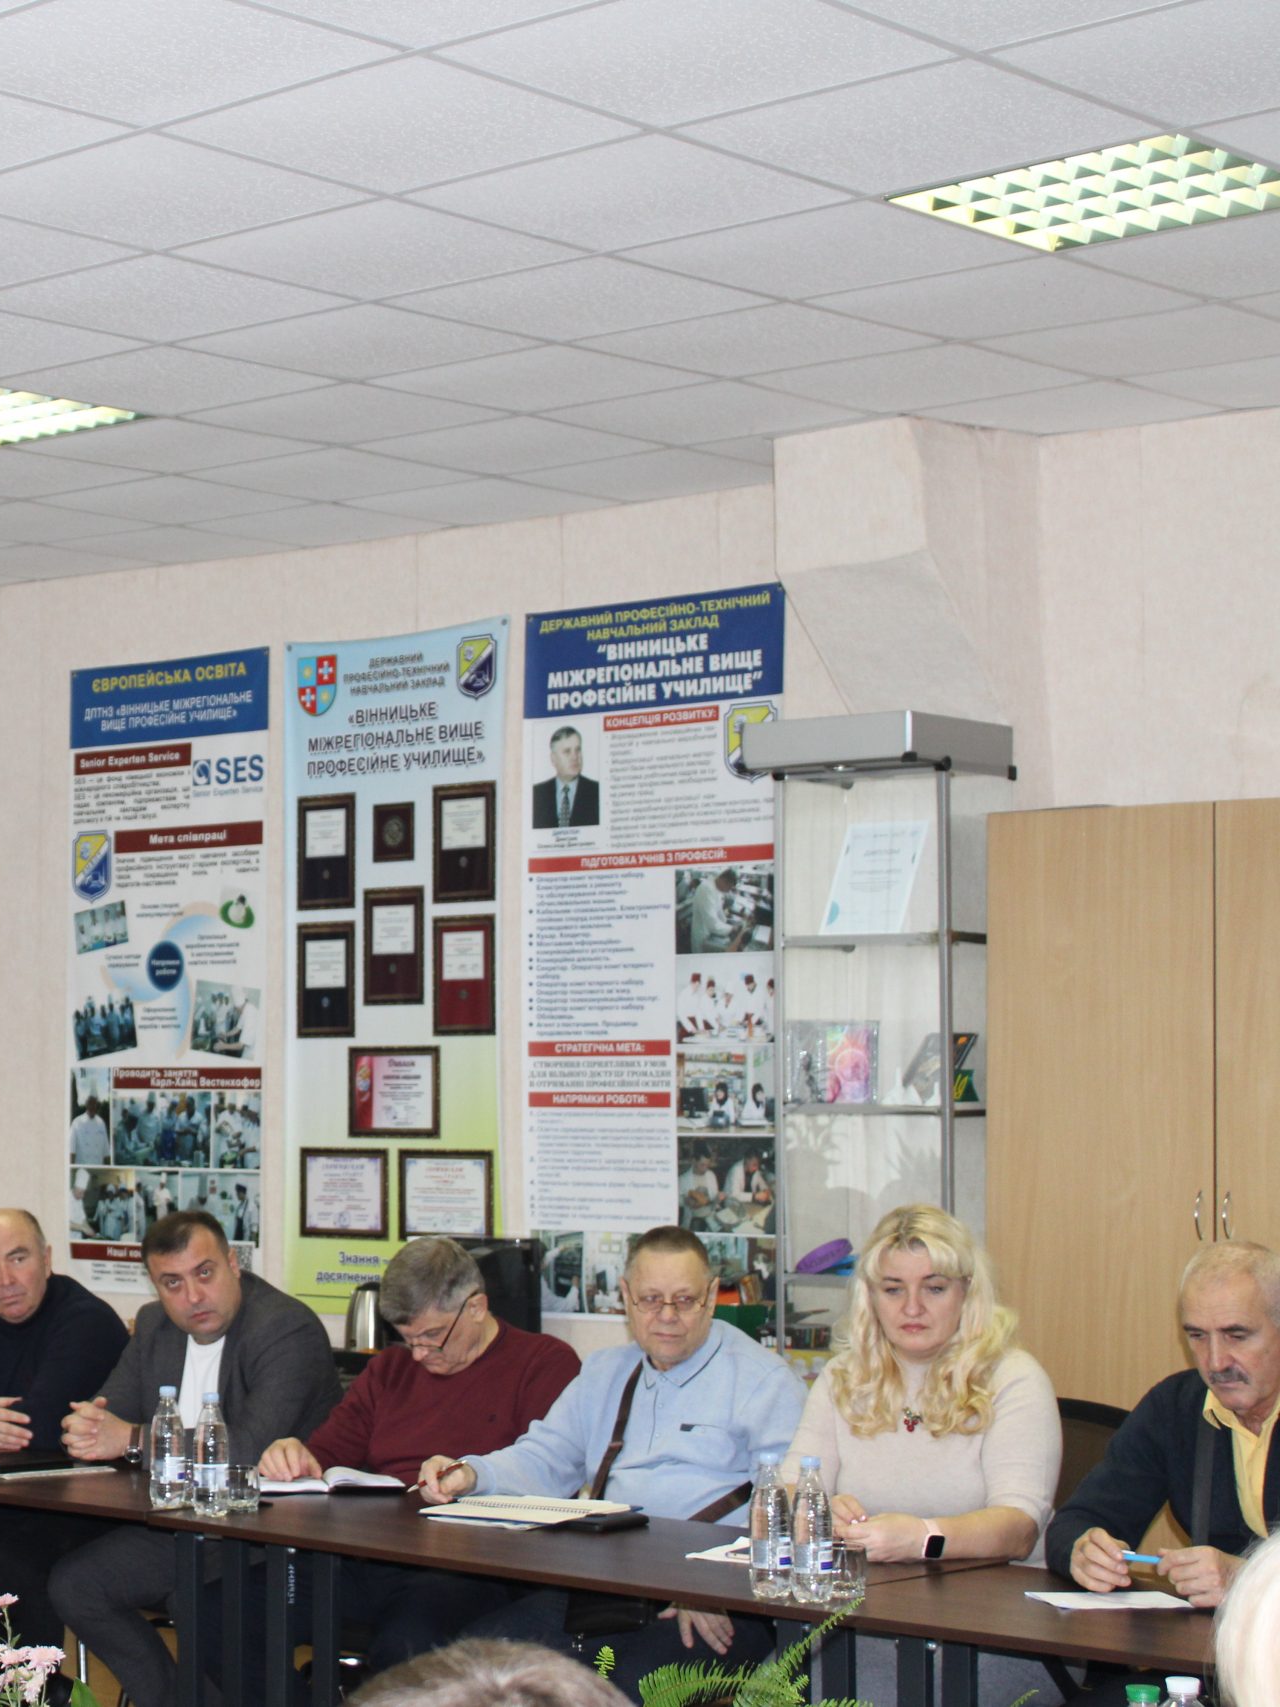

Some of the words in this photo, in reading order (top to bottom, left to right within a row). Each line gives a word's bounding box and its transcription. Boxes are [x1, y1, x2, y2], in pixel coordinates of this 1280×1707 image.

[540, 609, 612, 634] ДЕРЖАВНИЙ
[615, 592, 770, 623] ПРОФЕСІЙНО-ТЕХНІЧНИЙ
[587, 621, 666, 641] НАВЧАЛЬНИЙ
[670, 614, 719, 631] ЗАКЛАД
[92, 671, 192, 693] ЄВРОПЕЙСЬКА
[195, 662, 246, 682] ОСВІТА
[411, 676, 446, 689] ЗАКЛАД
[548, 654, 703, 689] МІЖРЕГІОНАЛЬНЕ
[709, 649, 762, 672] ВИЩЕ
[84, 707, 114, 722] ДПТНЗ
[116, 699, 170, 718] «ВІННИЦЬКЕ
[173, 690, 253, 711] МІЖРЕГІОНАЛЬНЕ
[547, 680, 657, 711] ПРОФЕСІЙНЕ
[101, 717, 126, 732] ВИЩЕ
[128, 711, 187, 729] ПРОФЕСІЙНЕ
[189, 705, 238, 723] УЧИЛИЩЕ»
[348, 702, 438, 727] «ВІННИЦЬКЕ
[606, 713, 660, 728] КОНЦЕПЦІЯ
[663, 708, 716, 722] РОЗВИТКУ:
[308, 726, 435, 754] МІЖРЕГІОНАЛЬНЕ
[438, 721, 484, 741] ВИЩЕ
[80, 757, 106, 769] Senior
[108, 754, 146, 767] Experten
[148, 751, 180, 762] Service
[215, 754, 264, 785] SES
[307, 753, 400, 778] ПРОФЕСІЙНЕ
[403, 746, 485, 770] УЧИЛИЩЕ»
[149, 833, 175, 845] Мета
[177, 829, 227, 843] співпраці
[581, 856, 637, 869] ПІДГОТОВКА
[638, 853, 667, 864] УЧНІВ
[674, 848, 727, 862] ПРОФЕСІЙ:
[554, 1043, 614, 1054] СТРАТЕГІЧНА
[615, 1042, 645, 1053] МЕТА:
[552, 1094, 605, 1105] НАПРЯМКИ
[606, 1093, 648, 1104] РОБОТИ:
[338, 1251, 380, 1265] Знання
